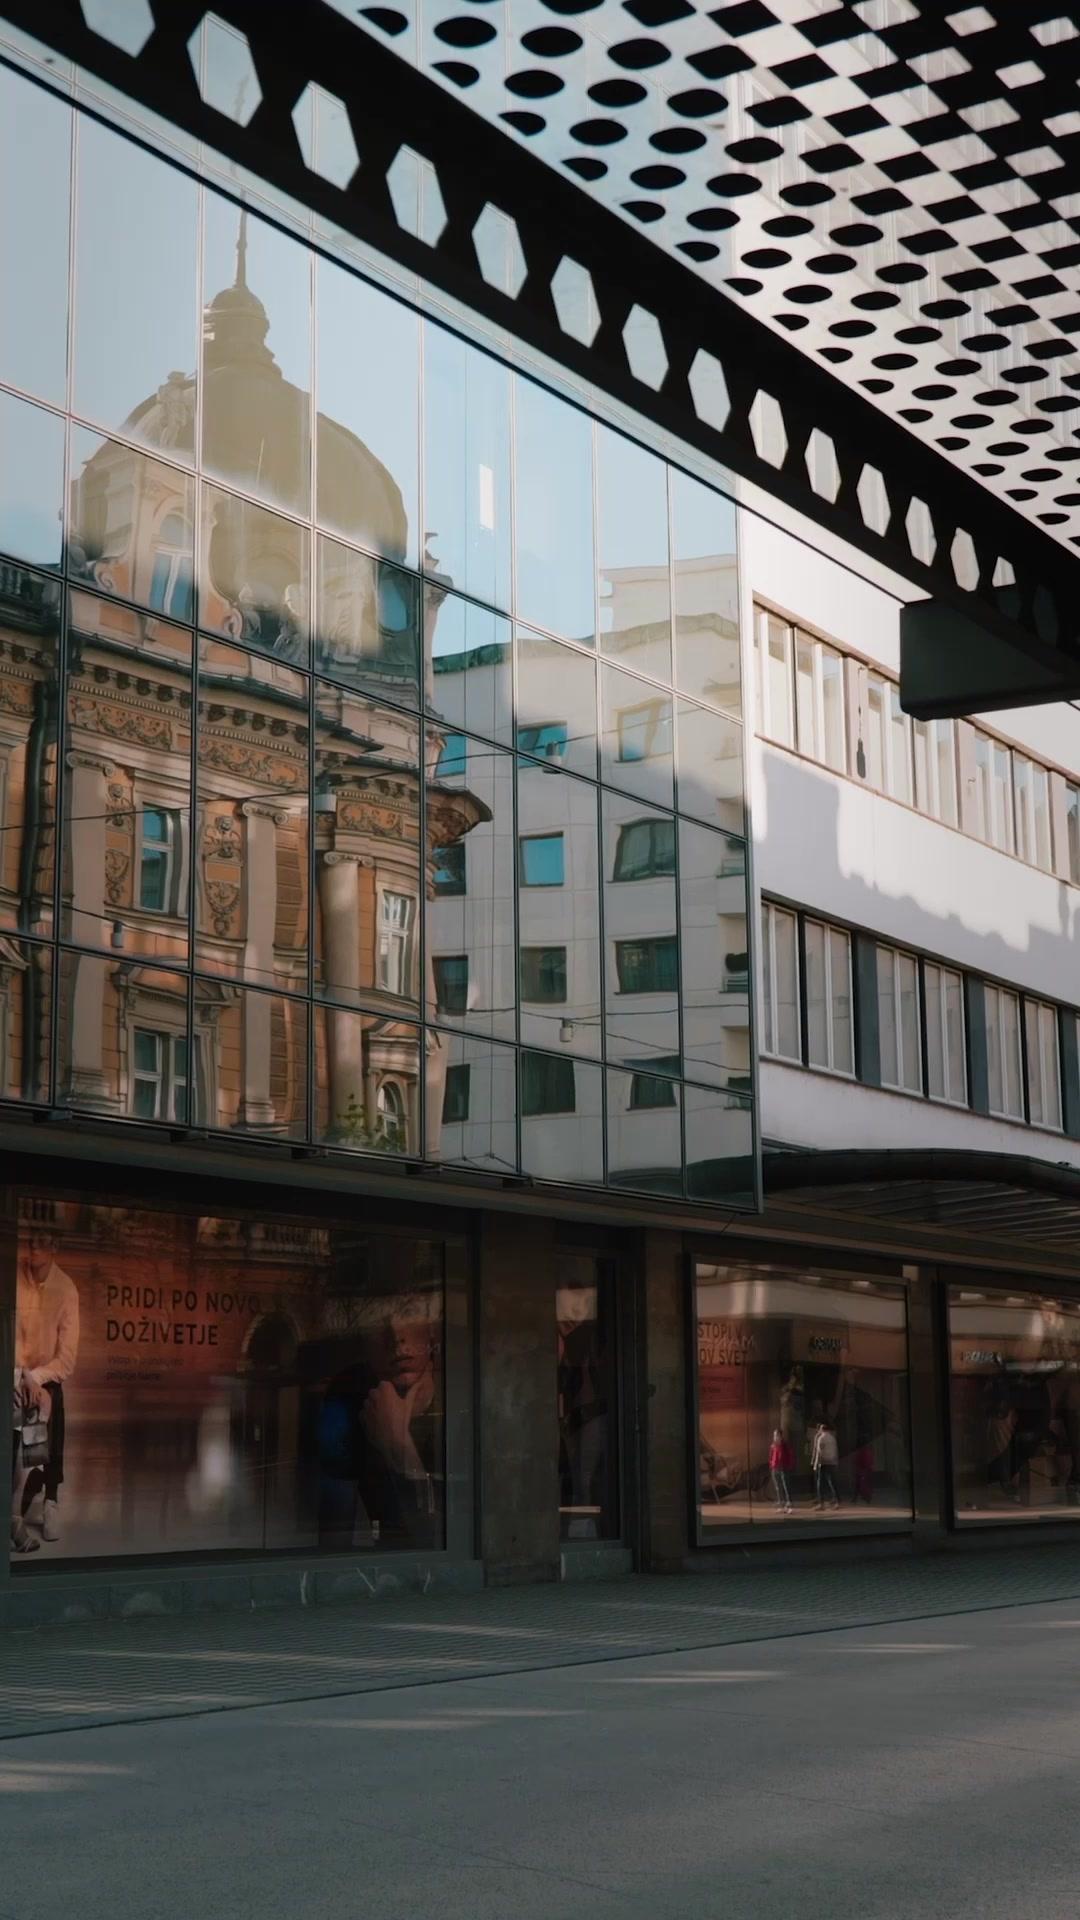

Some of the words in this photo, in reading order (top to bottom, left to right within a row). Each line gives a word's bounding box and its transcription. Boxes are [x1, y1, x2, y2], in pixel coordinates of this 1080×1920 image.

[107, 1285, 163, 1310] PRIDI
[172, 1289, 198, 1311] PO
[205, 1291, 261, 1315] NOVO
[106, 1316, 219, 1346] DOŽIVETJE
[719, 1349, 748, 1366] SVET
